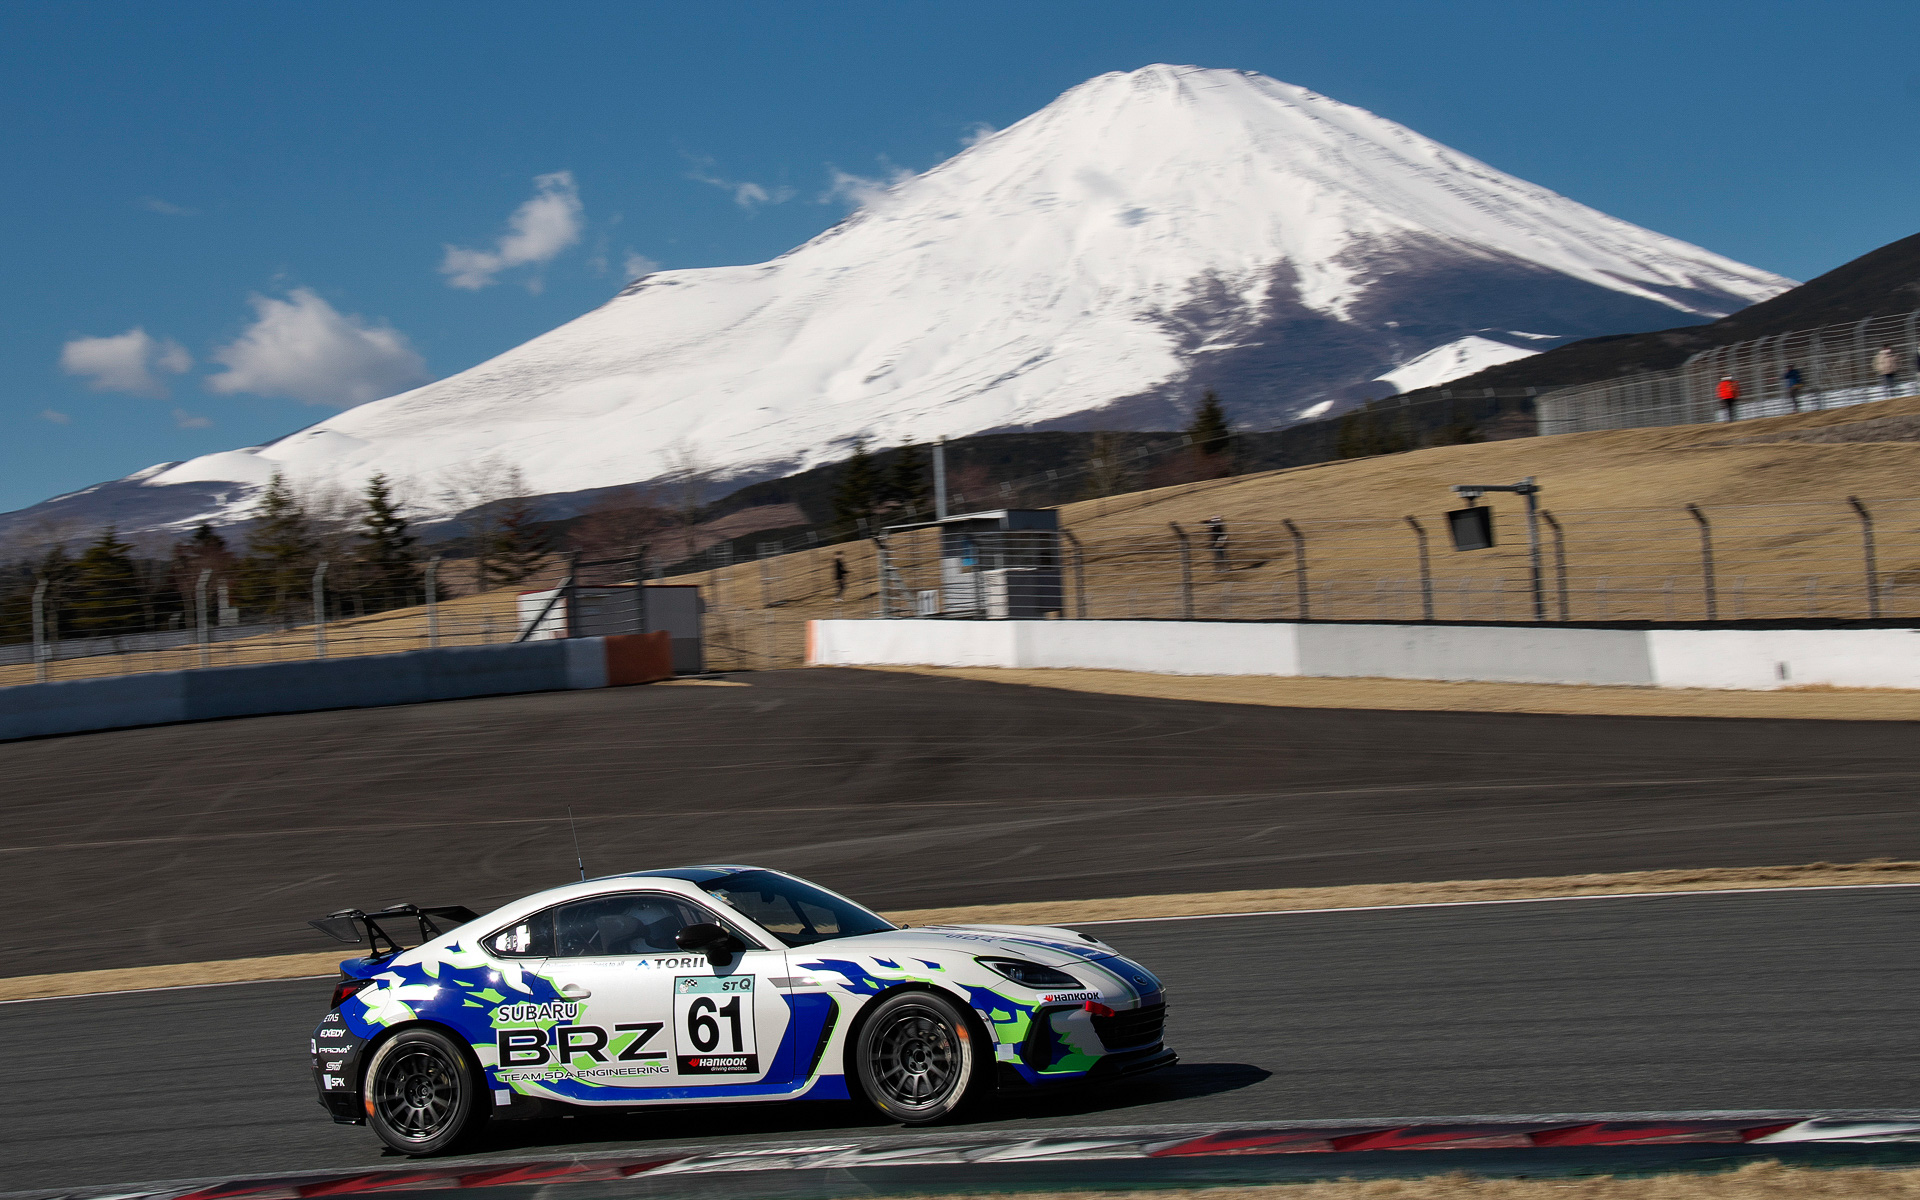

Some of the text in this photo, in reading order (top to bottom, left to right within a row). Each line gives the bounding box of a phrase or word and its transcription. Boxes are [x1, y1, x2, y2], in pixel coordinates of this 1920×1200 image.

[654, 957, 705, 969] TORII
[498, 1003, 578, 1022] SUBARU
[688, 995, 743, 1053] 61
[320, 1029, 346, 1038] EXEDY
[498, 1022, 668, 1068] BRZ
[331, 1077, 346, 1087] SPK
[501, 1066, 670, 1082] TEAM SDA ENGINEERING
